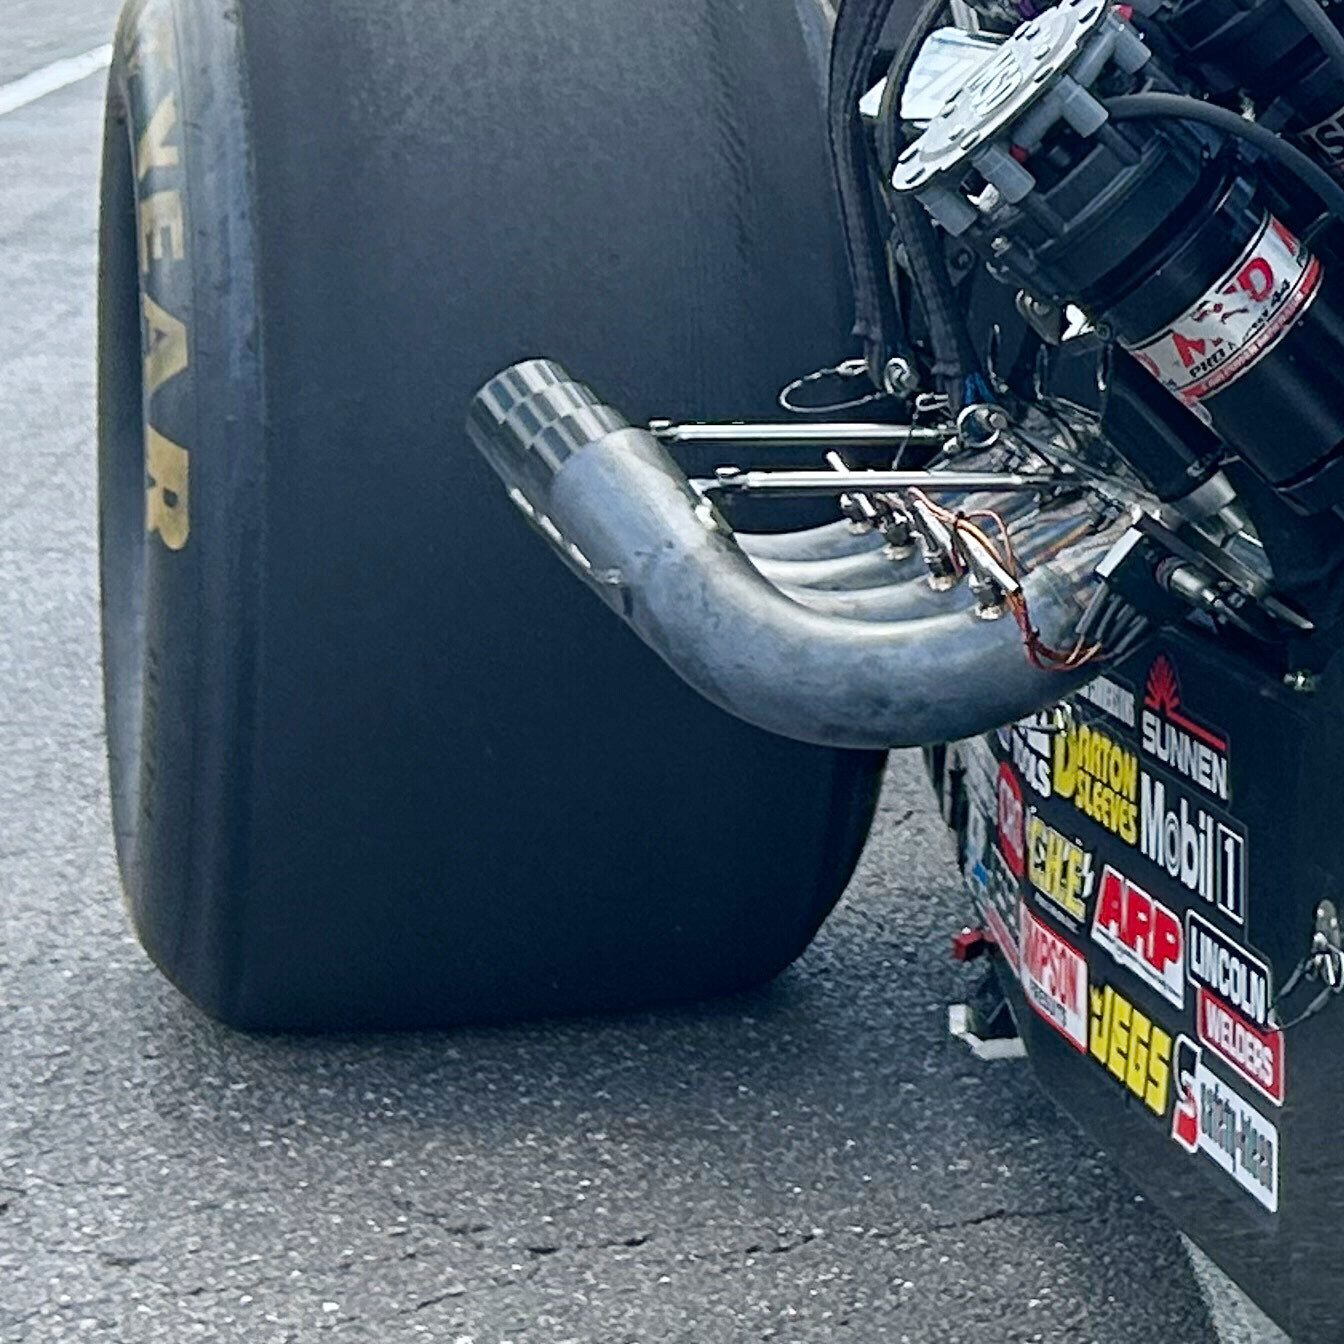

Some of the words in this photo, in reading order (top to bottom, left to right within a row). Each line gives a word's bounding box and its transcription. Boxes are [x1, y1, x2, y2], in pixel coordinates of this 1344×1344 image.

[1074, 767, 1138, 846] SLEEVES
[1142, 709, 1228, 801] SUNNEN
[1140, 771, 1215, 903] Mobil
[1097, 870, 1183, 974] ARP
[1189, 923, 1267, 1026] LINCOLN
[1089, 983, 1173, 1117] JEGS
[1205, 997, 1274, 1088] WELDERS
